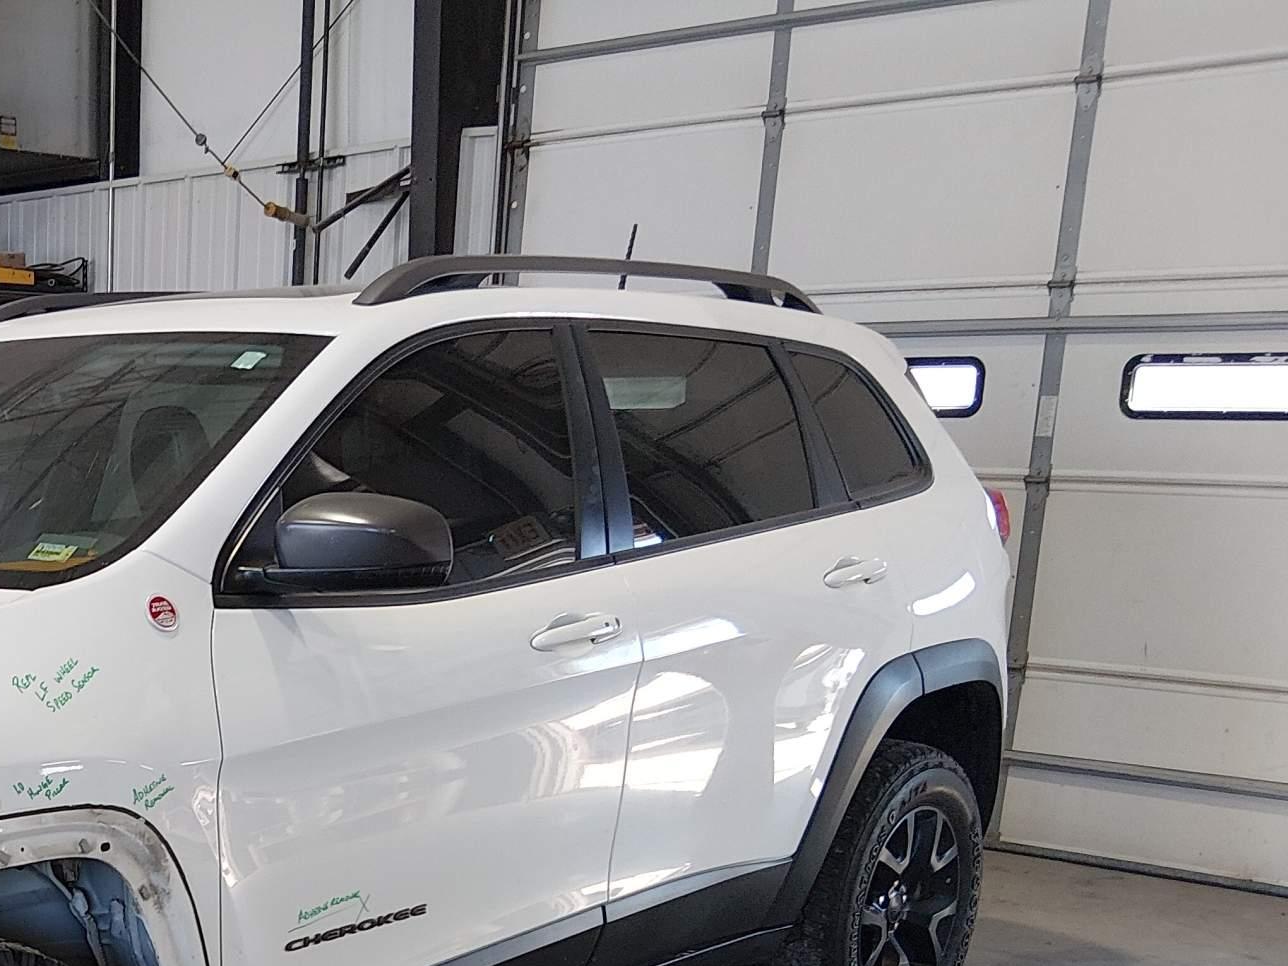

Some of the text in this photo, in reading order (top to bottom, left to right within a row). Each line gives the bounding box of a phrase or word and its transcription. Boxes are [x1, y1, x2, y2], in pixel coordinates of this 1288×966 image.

[35, 657, 78, 701] LF WHEEL
[46, 691, 73, 712] SPEED
[284, 903, 428, 952] CHEROKEE
